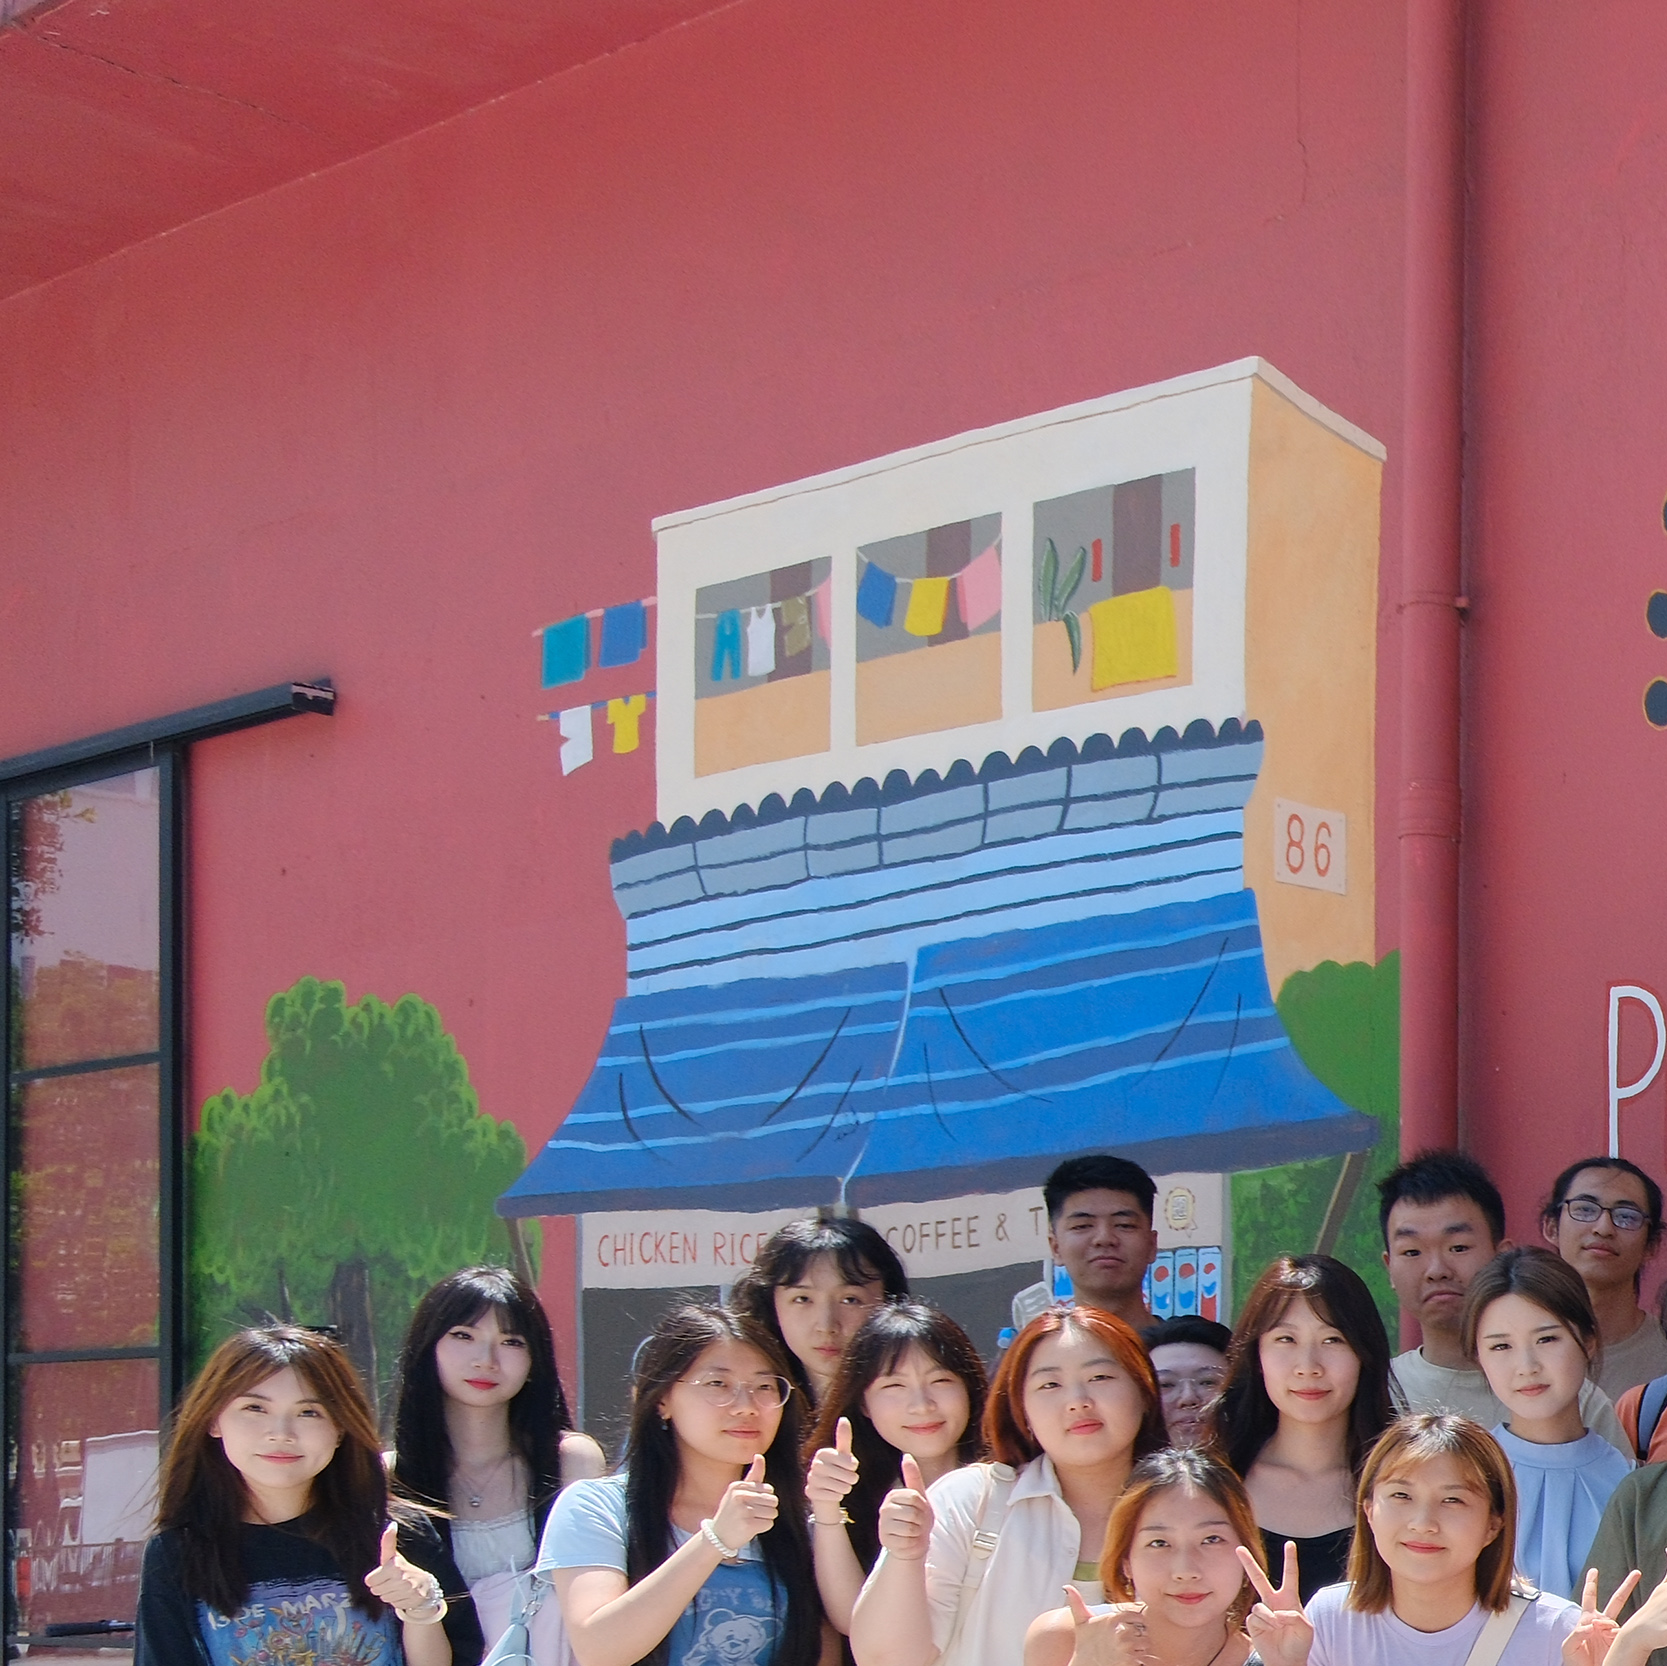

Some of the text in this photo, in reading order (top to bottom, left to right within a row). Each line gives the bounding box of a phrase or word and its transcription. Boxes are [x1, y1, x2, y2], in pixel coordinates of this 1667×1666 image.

[1286, 814, 1332, 877] 86
[597, 1231, 697, 1267] CHICKEN
[886, 1215, 980, 1254] COFFEE
